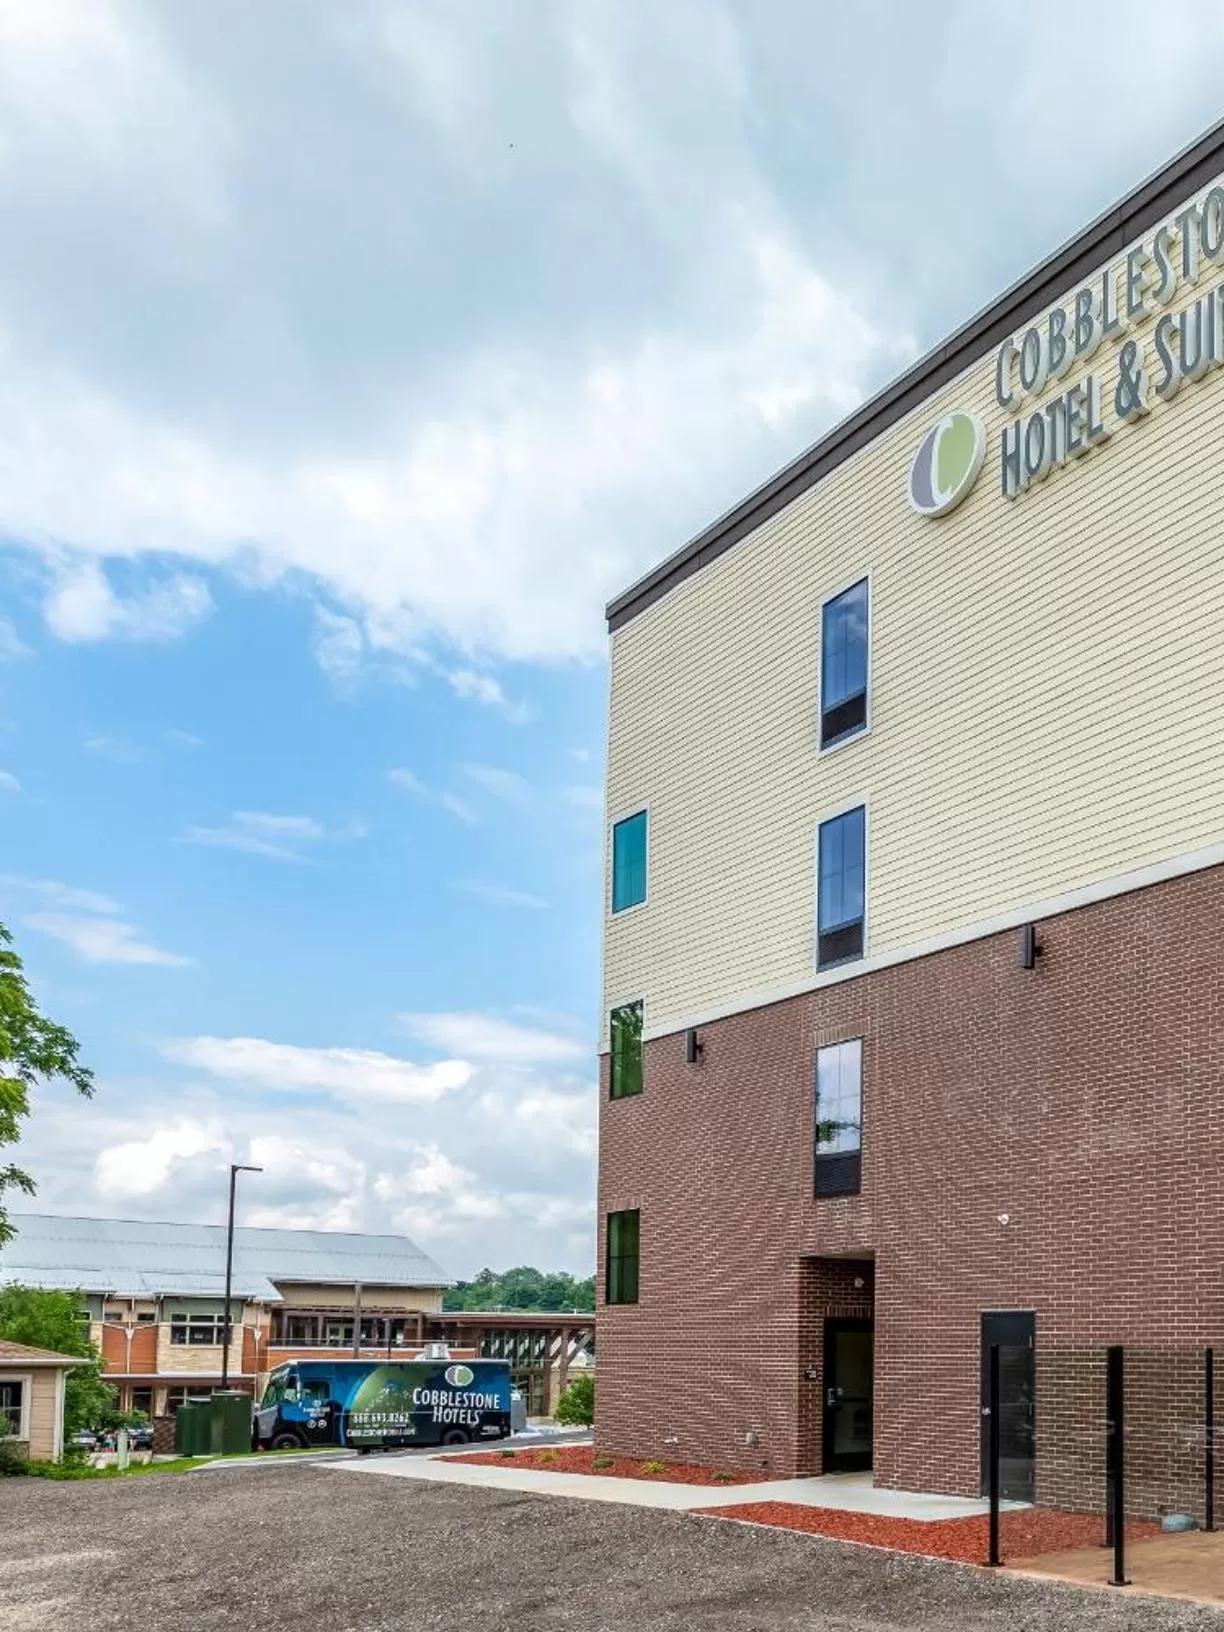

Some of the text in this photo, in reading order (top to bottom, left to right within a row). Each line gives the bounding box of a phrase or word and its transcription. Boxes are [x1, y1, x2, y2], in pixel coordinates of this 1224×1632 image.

[1001, 376, 1110, 499] HOTEL
[1115, 340, 1150, 423] &
[413, 1387, 500, 1409] COBBLESTONE
[432, 1406, 480, 1424] HOTELS
